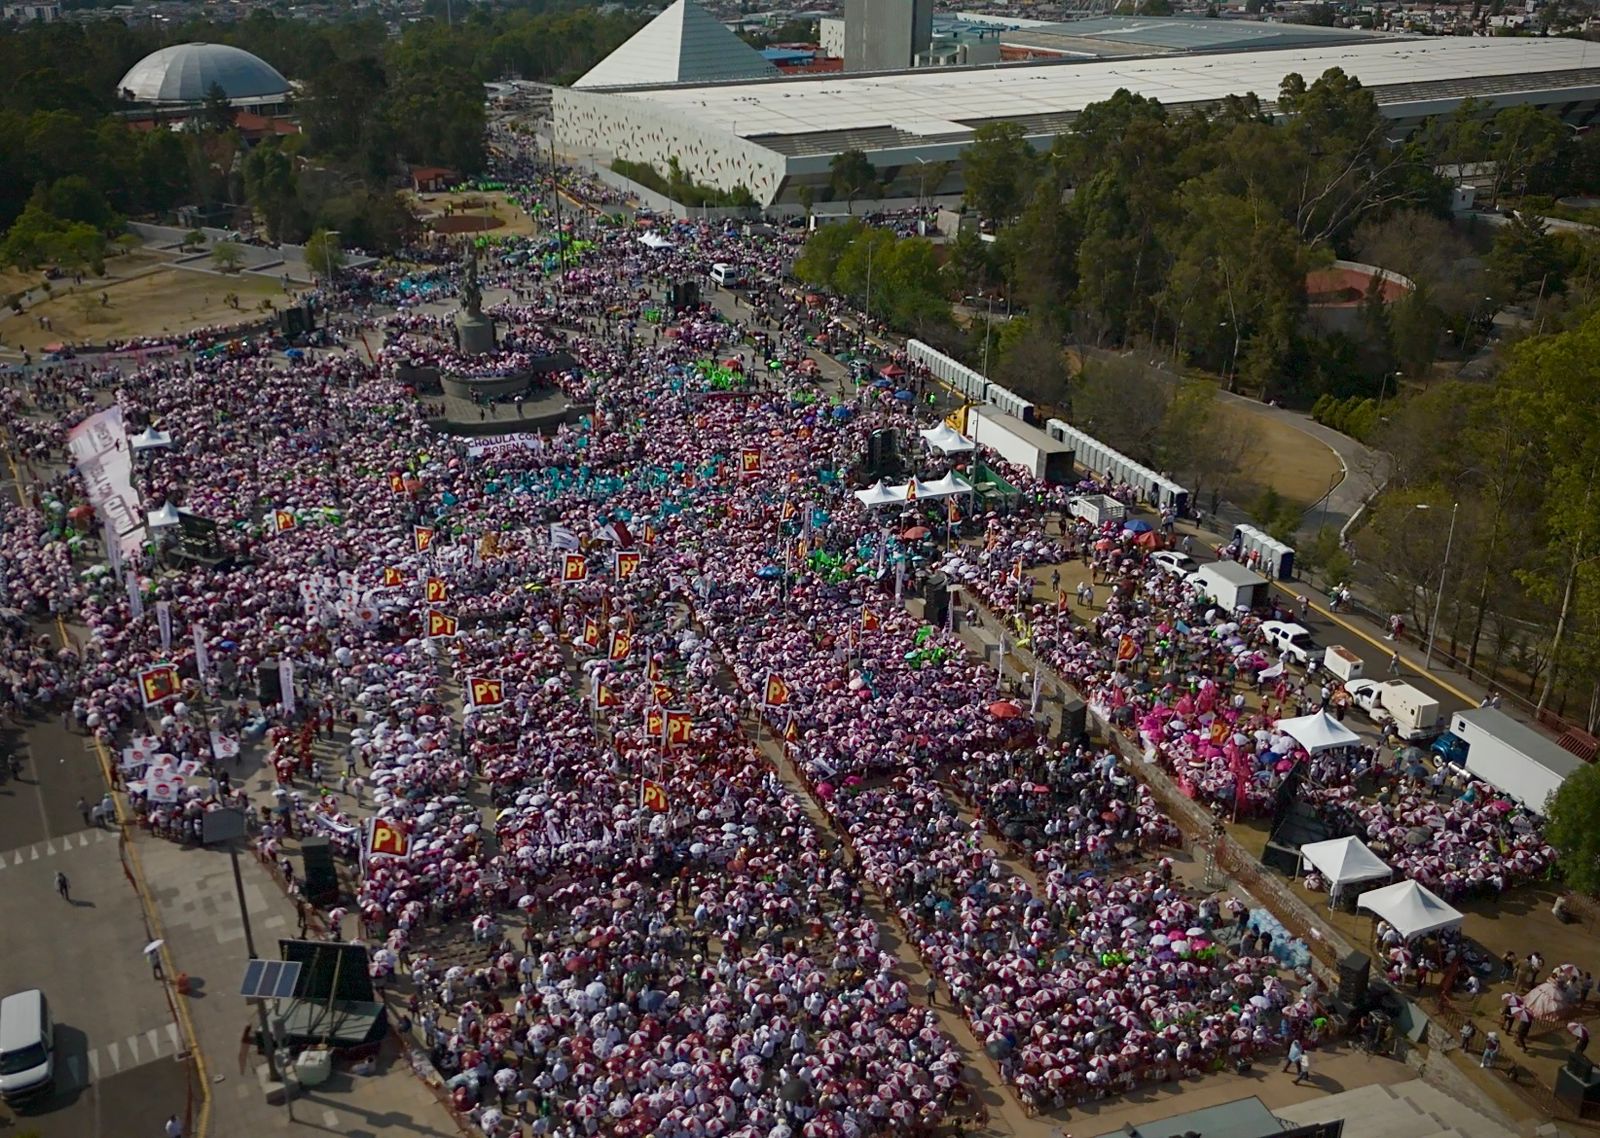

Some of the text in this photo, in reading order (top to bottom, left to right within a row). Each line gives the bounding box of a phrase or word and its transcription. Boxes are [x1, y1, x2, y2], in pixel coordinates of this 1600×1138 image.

[468, 431, 539, 448] CHOLULA CON
[483, 441, 528, 454] MORENA
[743, 454, 759, 470] PT
[566, 560, 585, 579] PT
[620, 560, 639, 577] PT
[429, 582, 446, 601] PT
[432, 616, 455, 634] PT
[475, 683, 500, 703] PT
[668, 718, 692, 741] PT
[645, 786, 666, 809] PT
[374, 828, 403, 852] PT
